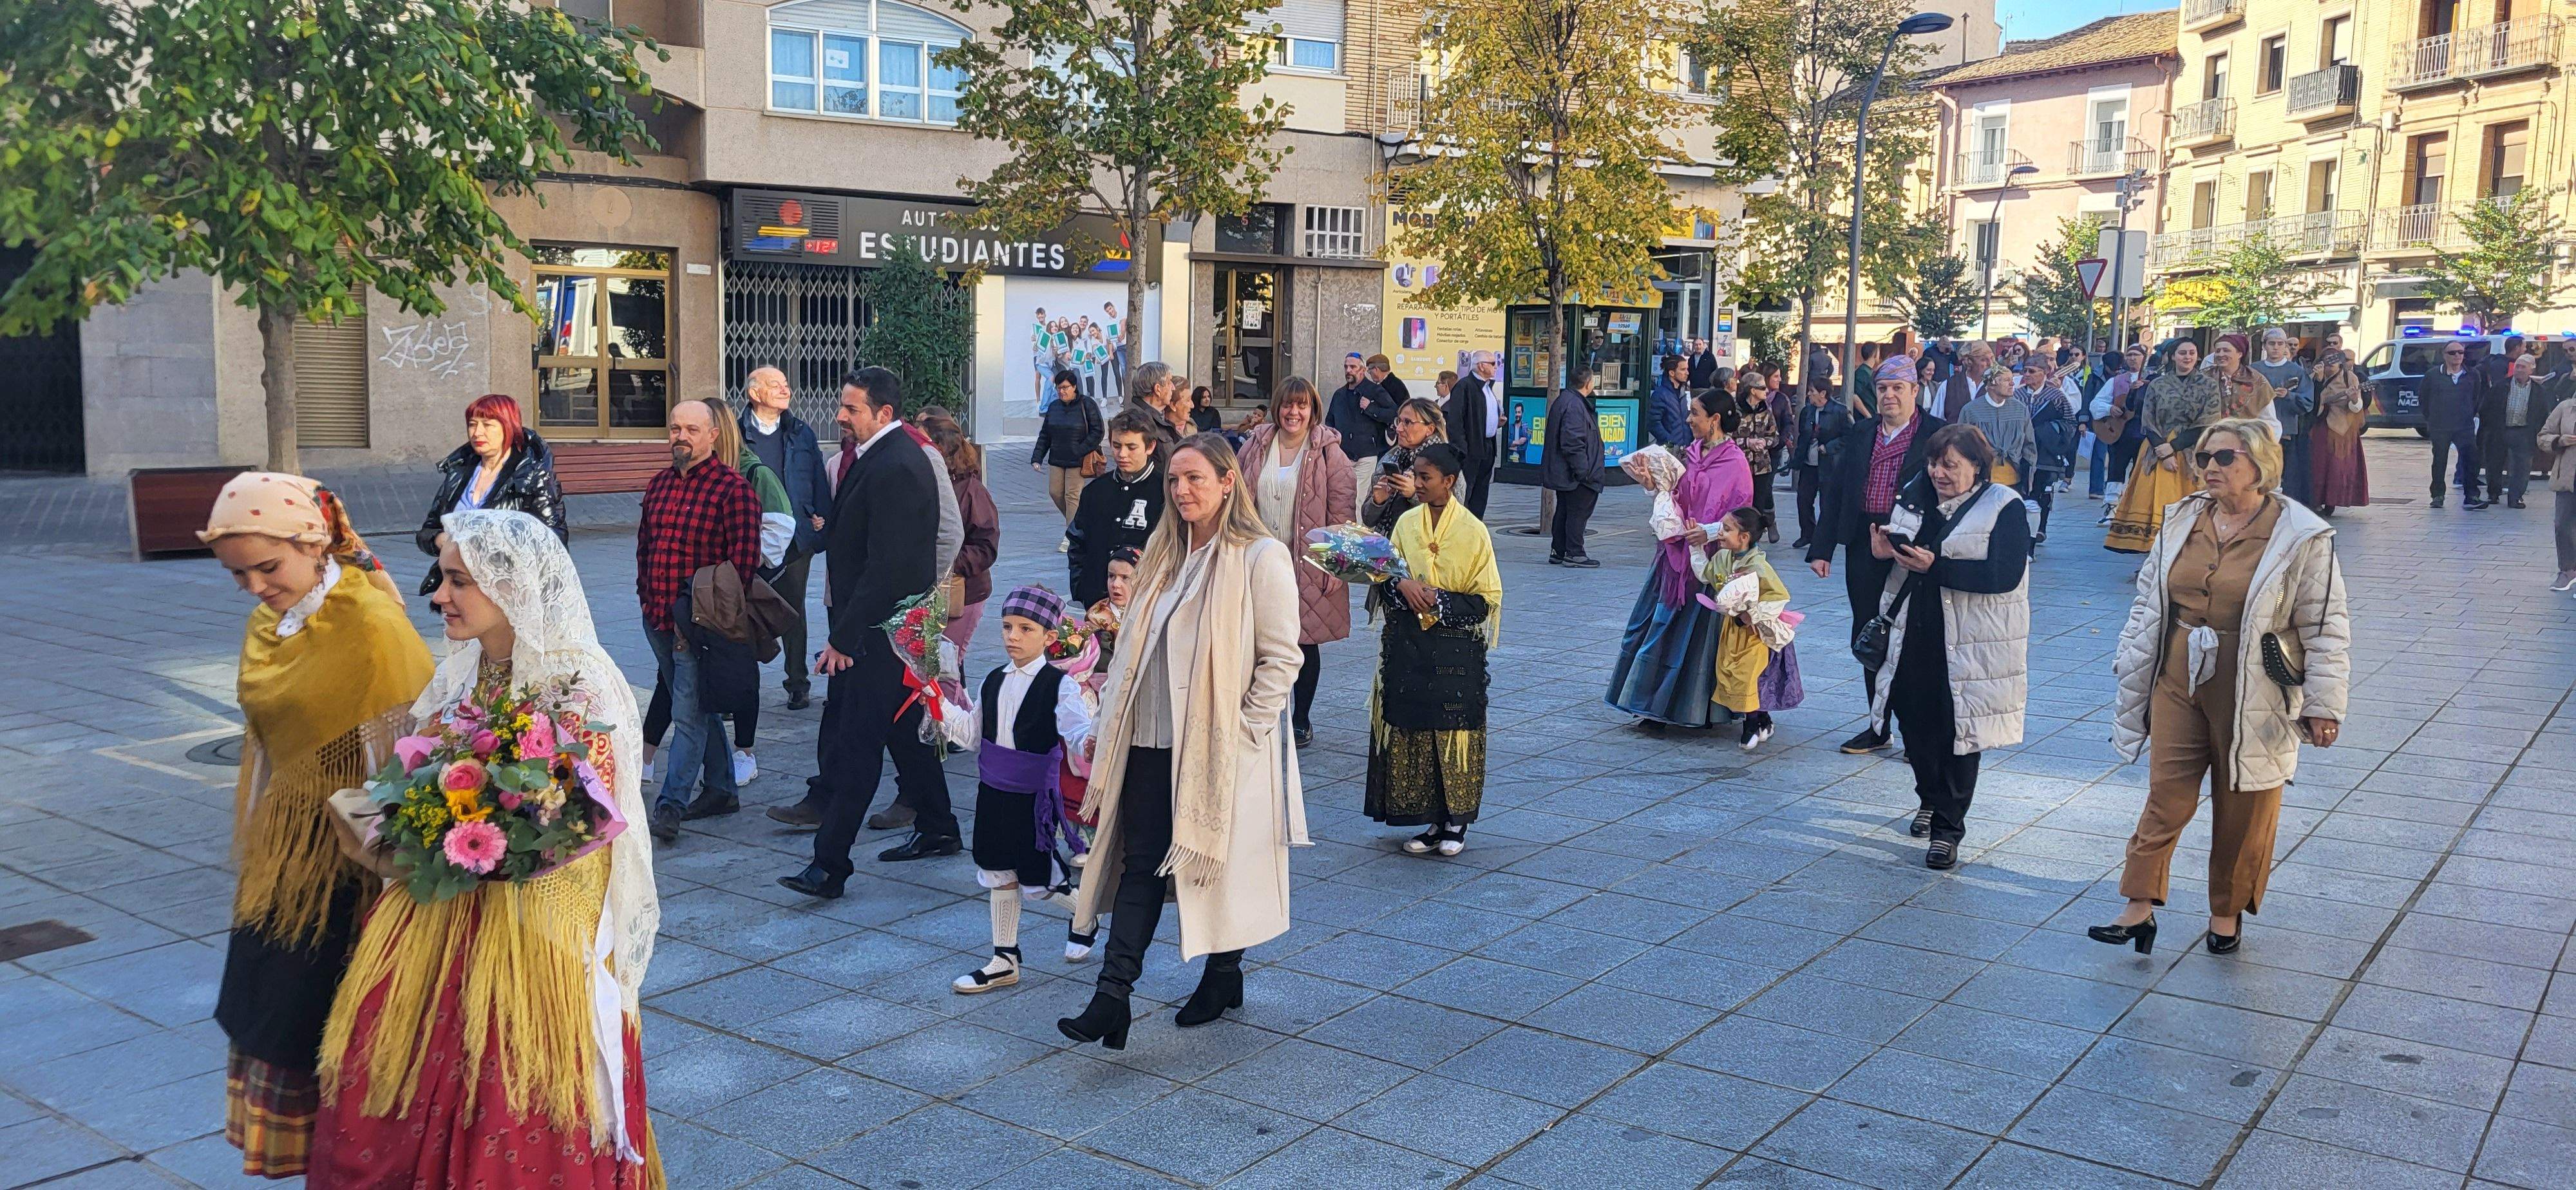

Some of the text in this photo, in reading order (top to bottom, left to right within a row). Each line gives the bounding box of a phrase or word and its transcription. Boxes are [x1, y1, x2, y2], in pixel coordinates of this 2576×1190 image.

[1440, 312, 1479, 321] PORTÁTILES
[2399, 390, 2420, 399] POL
[1599, 414, 1626, 428] BIEN
[1600, 427, 1626, 443] UGADO
[1122, 499, 1148, 530] A
